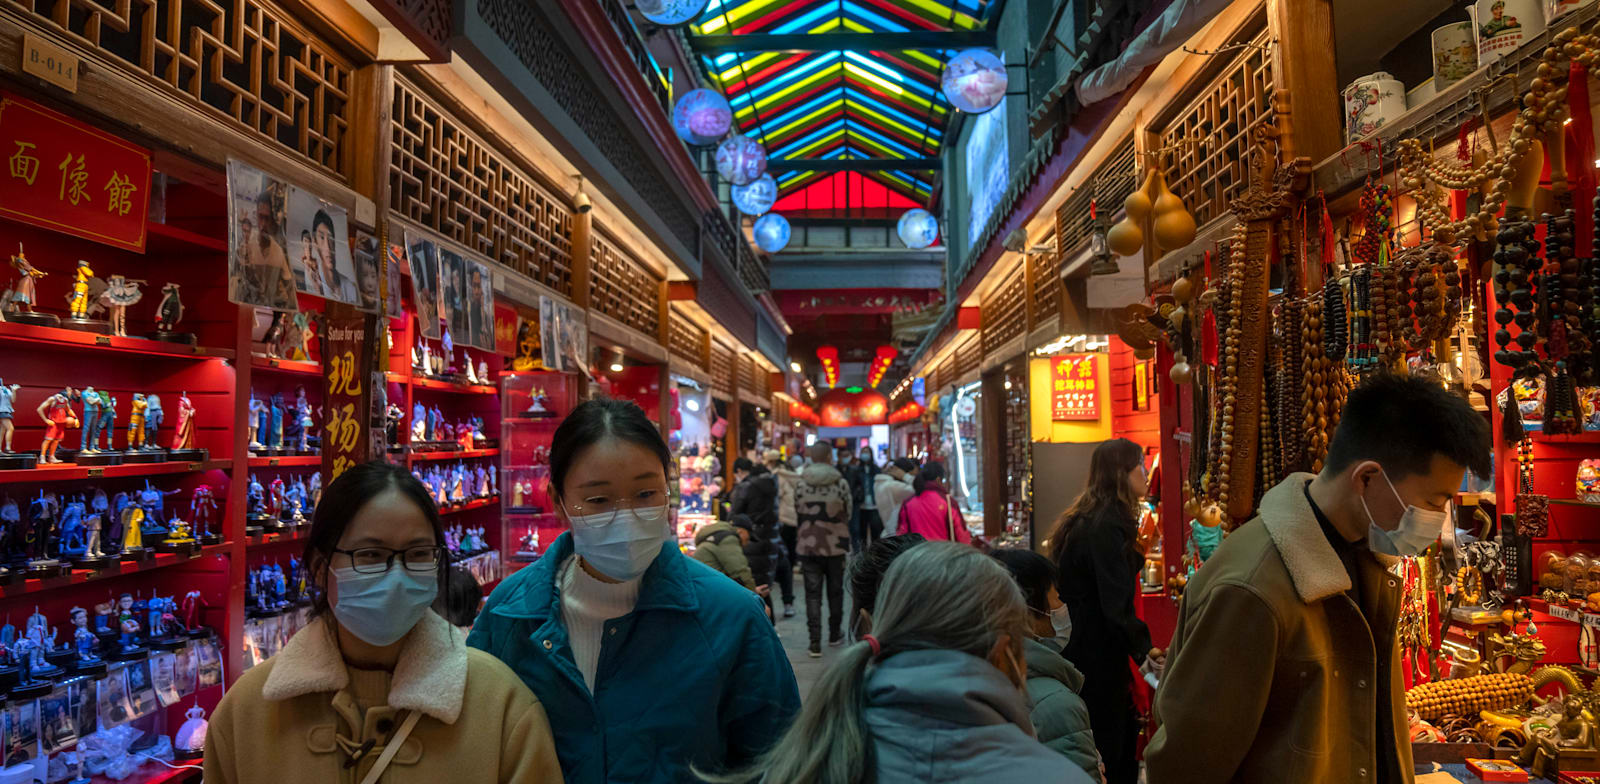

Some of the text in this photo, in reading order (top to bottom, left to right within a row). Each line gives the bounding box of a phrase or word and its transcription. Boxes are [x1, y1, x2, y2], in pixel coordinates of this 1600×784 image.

[31, 47, 73, 79] B-014
[345, 325, 353, 341] for
[353, 329, 364, 344] you
